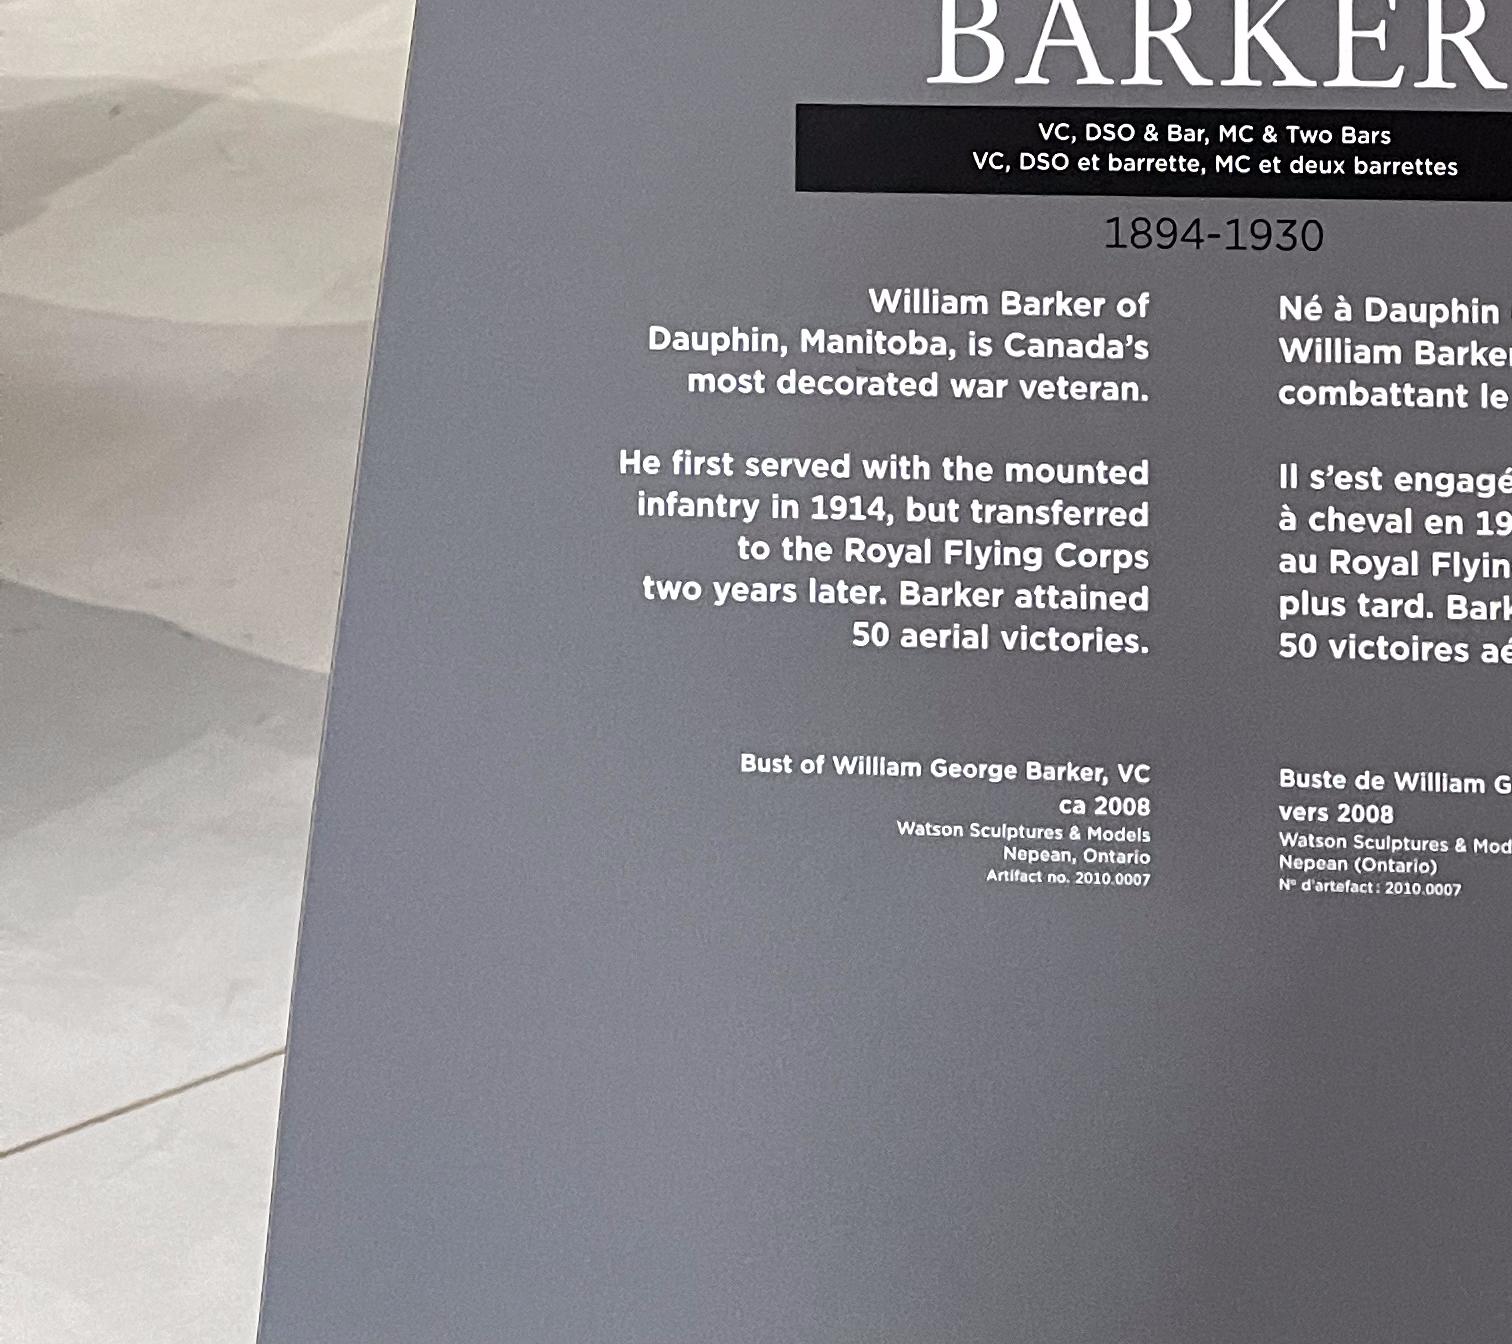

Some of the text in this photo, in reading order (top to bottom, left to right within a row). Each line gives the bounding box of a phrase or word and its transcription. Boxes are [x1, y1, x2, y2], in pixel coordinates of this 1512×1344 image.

[1038, 122, 1392, 146] VC, DSO & Bar, MC & Two Bars
[972, 151, 1458, 176] VC, DSO et barrette, MC et deux barrettes
[1105, 216, 1324, 252] 1894-1930
[868, 287, 1150, 318] William Barker of
[1279, 294, 1323, 322] Né
[1334, 294, 1352, 322] à
[1365, 296, 1500, 329] Dauphin
[649, 325, 788, 358] Dauphin,
[800, 328, 956, 361] Manitoba,
[968, 330, 993, 357] is
[1278, 337, 1402, 365] William
[688, 368, 1149, 402] most decorated war veteran.
[1278, 379, 1469, 409] combattant
[1480, 382, 1509, 410] le
[619, 448, 1149, 486] He first served with the mounted
[1280, 462, 1298, 489] Il
[638, 490, 1149, 528] infantry in 1914, but transferred
[1278, 503, 1297, 531] à
[1308, 505, 1412, 534] cheval
[1424, 514, 1464, 535] en
[737, 535, 1149, 574] to the Royal Flying Corps
[1278, 553, 1317, 574] au
[1330, 548, 1419, 581] Royal
[642, 575, 1149, 612] two years later. Barker attained
[1279, 589, 1346, 621] plus
[1357, 592, 1434, 619] tard.
[852, 621, 1149, 654] 50 aerial victories.
[1279, 632, 1318, 659] 50
[1328, 633, 1470, 663] victoires
[740, 753, 1151, 786] Bust of William George Barker, VC
[1279, 768, 1347, 790] Buste
[1354, 770, 1385, 791] de
[1393, 771, 1486, 794] William
[1058, 795, 1151, 817] ca 2008
[1278, 803, 1394, 824] vers 2008
[896, 819, 1151, 843] Watson Sculptures & Models
[1278, 831, 1347, 849] Watson
[1353, 834, 1449, 854] Sculptures
[1454, 837, 1467, 853] &
[1003, 845, 1151, 865] Nepean, Ontario
[1279, 854, 1438, 877] Nepean (Ontario)
[986, 868, 1151, 887] Artifact no. 2010.0007
[1385, 881, 1462, 897] 2010.0007
